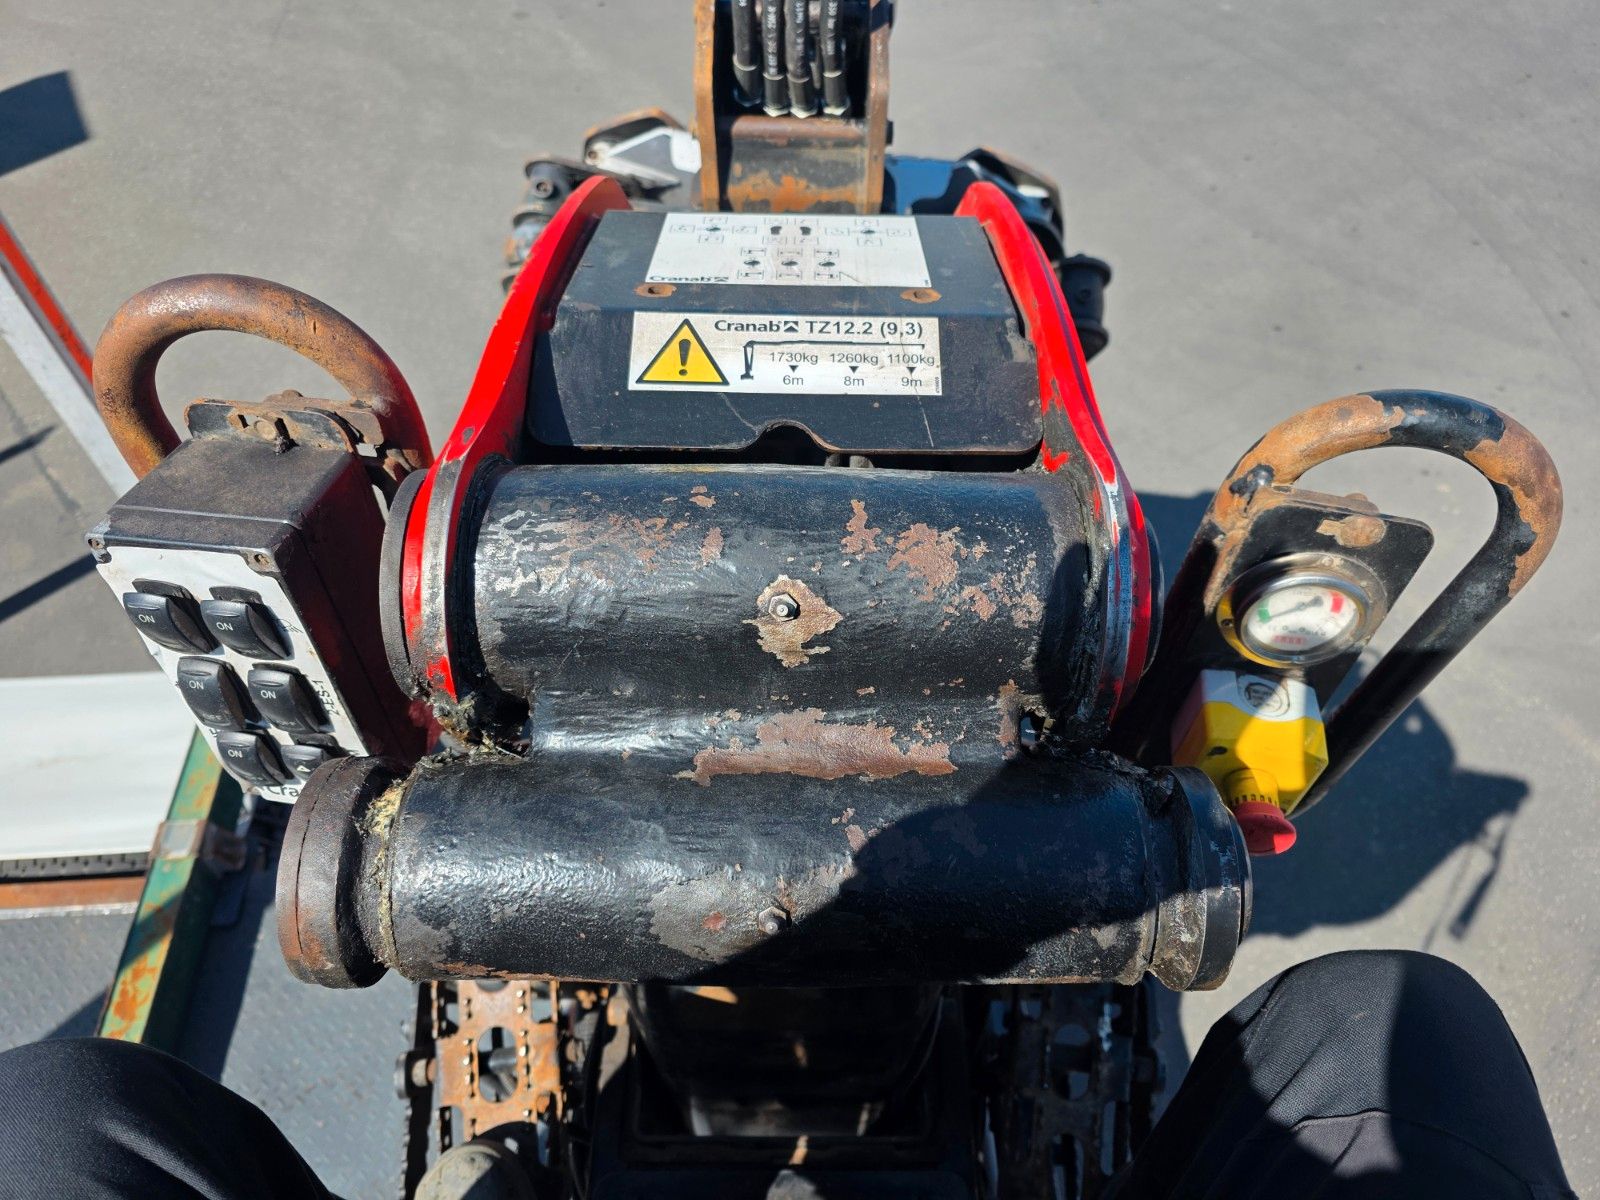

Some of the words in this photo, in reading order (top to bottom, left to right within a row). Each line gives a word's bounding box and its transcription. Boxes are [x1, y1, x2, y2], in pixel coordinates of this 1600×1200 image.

[649, 275, 711, 284] Cranab
[714, 319, 780, 333] Cranab
[805, 321, 873, 335] TZ12.2
[879, 321, 924, 338] (9,3)
[769, 352, 819, 366] 1730kg
[829, 352, 879, 366] 1260kg
[888, 353, 935, 367] 1100kg
[782, 375, 805, 386] 6m
[843, 375, 865, 387] 8m
[901, 376, 923, 387] 9m
[138, 614, 156, 624] ON
[216, 621, 233, 632] ON
[188, 680, 205, 690] ON
[260, 689, 277, 700] ON
[227, 749, 243, 759] ON
[266, 785, 300, 798] Cra
